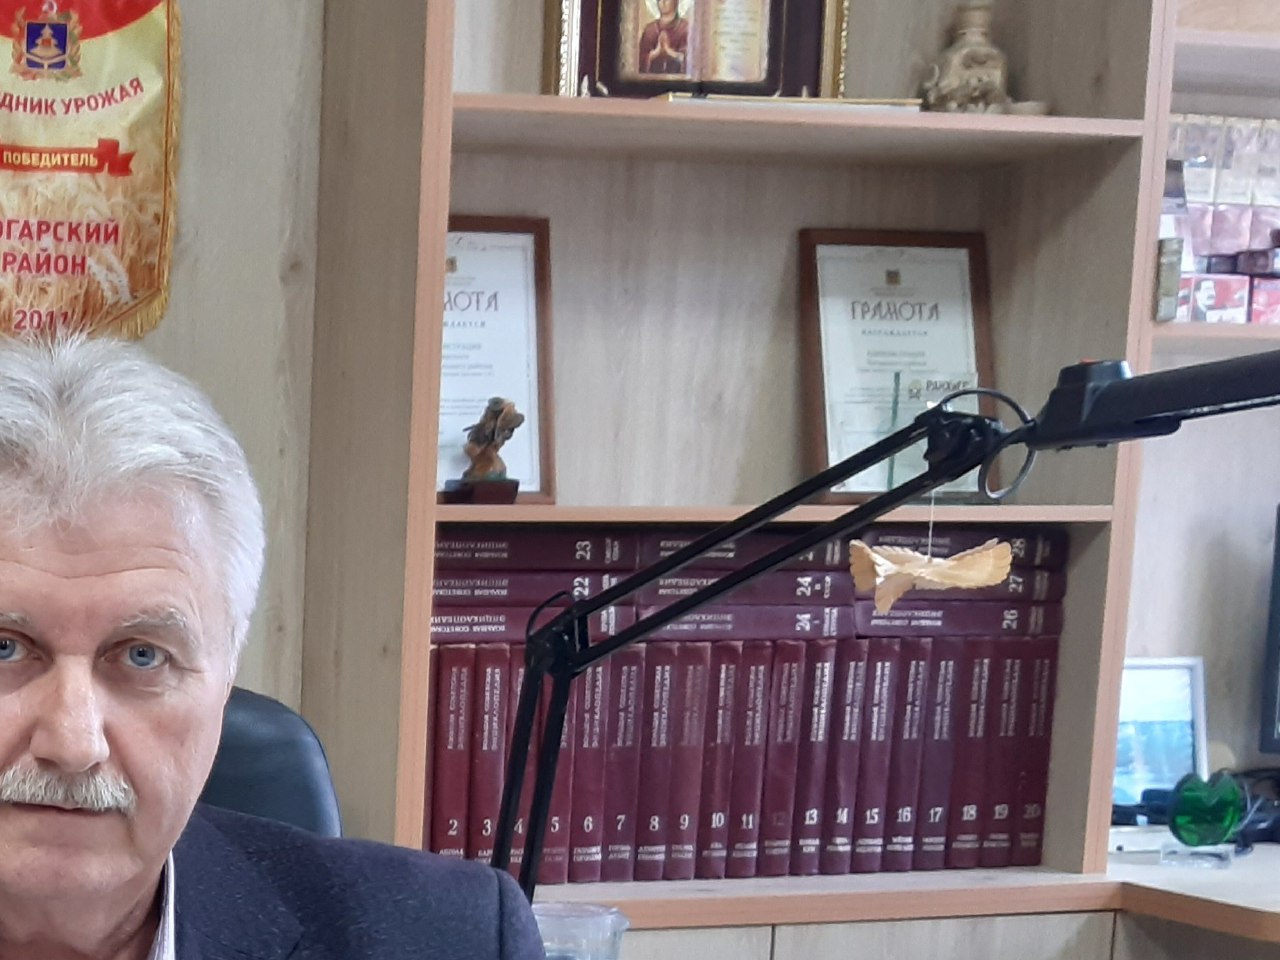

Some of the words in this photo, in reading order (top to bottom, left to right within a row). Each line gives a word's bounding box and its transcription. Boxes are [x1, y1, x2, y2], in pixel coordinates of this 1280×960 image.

[61, 77, 144, 116] УРОЖАЯ
[3, 151, 99, 169] ПОБЕДИТЕЛЬ
[1, 249, 87, 276] РАЙОН
[851, 301, 940, 322] ГРАМОТА
[576, 541, 592, 560] 23
[574, 577, 589, 597] 22
[796, 576, 812, 597] 24
[796, 612, 811, 632] 24
[1003, 610, 1019, 629] 26
[711, 812, 724, 829] 10
[805, 808, 817, 825] 13
[836, 808, 848, 824] 14
[865, 808, 878, 824] 15
[897, 806, 911, 823] 16
[929, 807, 943, 822] 17
[962, 804, 977, 821] 18
[994, 804, 1008, 820] 19
[448, 819, 458, 836] 2
[482, 818, 491, 836] 3
[514, 818, 523, 834] 4
[551, 816, 560, 832] 5
[584, 816, 593, 832] 6
[616, 815, 625, 830] 7
[649, 815, 659, 831] 8
[680, 814, 689, 830] 9
[742, 813, 753, 829] 11
